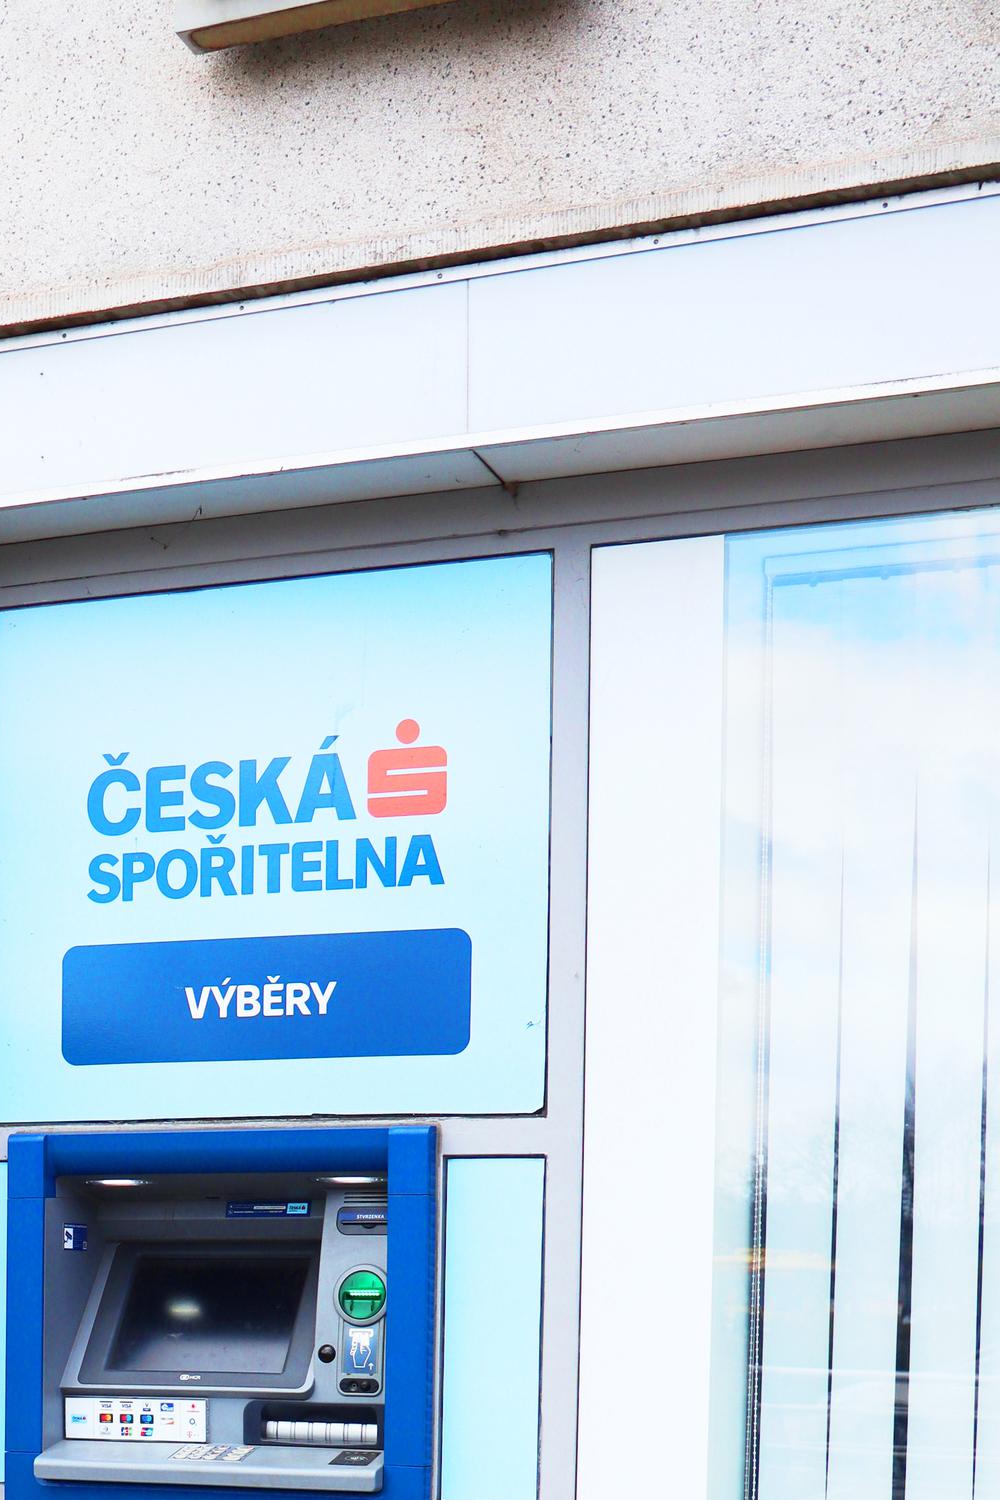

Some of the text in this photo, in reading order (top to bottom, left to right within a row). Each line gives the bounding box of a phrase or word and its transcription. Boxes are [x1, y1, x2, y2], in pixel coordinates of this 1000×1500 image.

[87, 734, 357, 836] ČESKÁ
[87, 834, 445, 903] SPOŘITELNA
[185, 975, 338, 1019] VÝBĚRY
